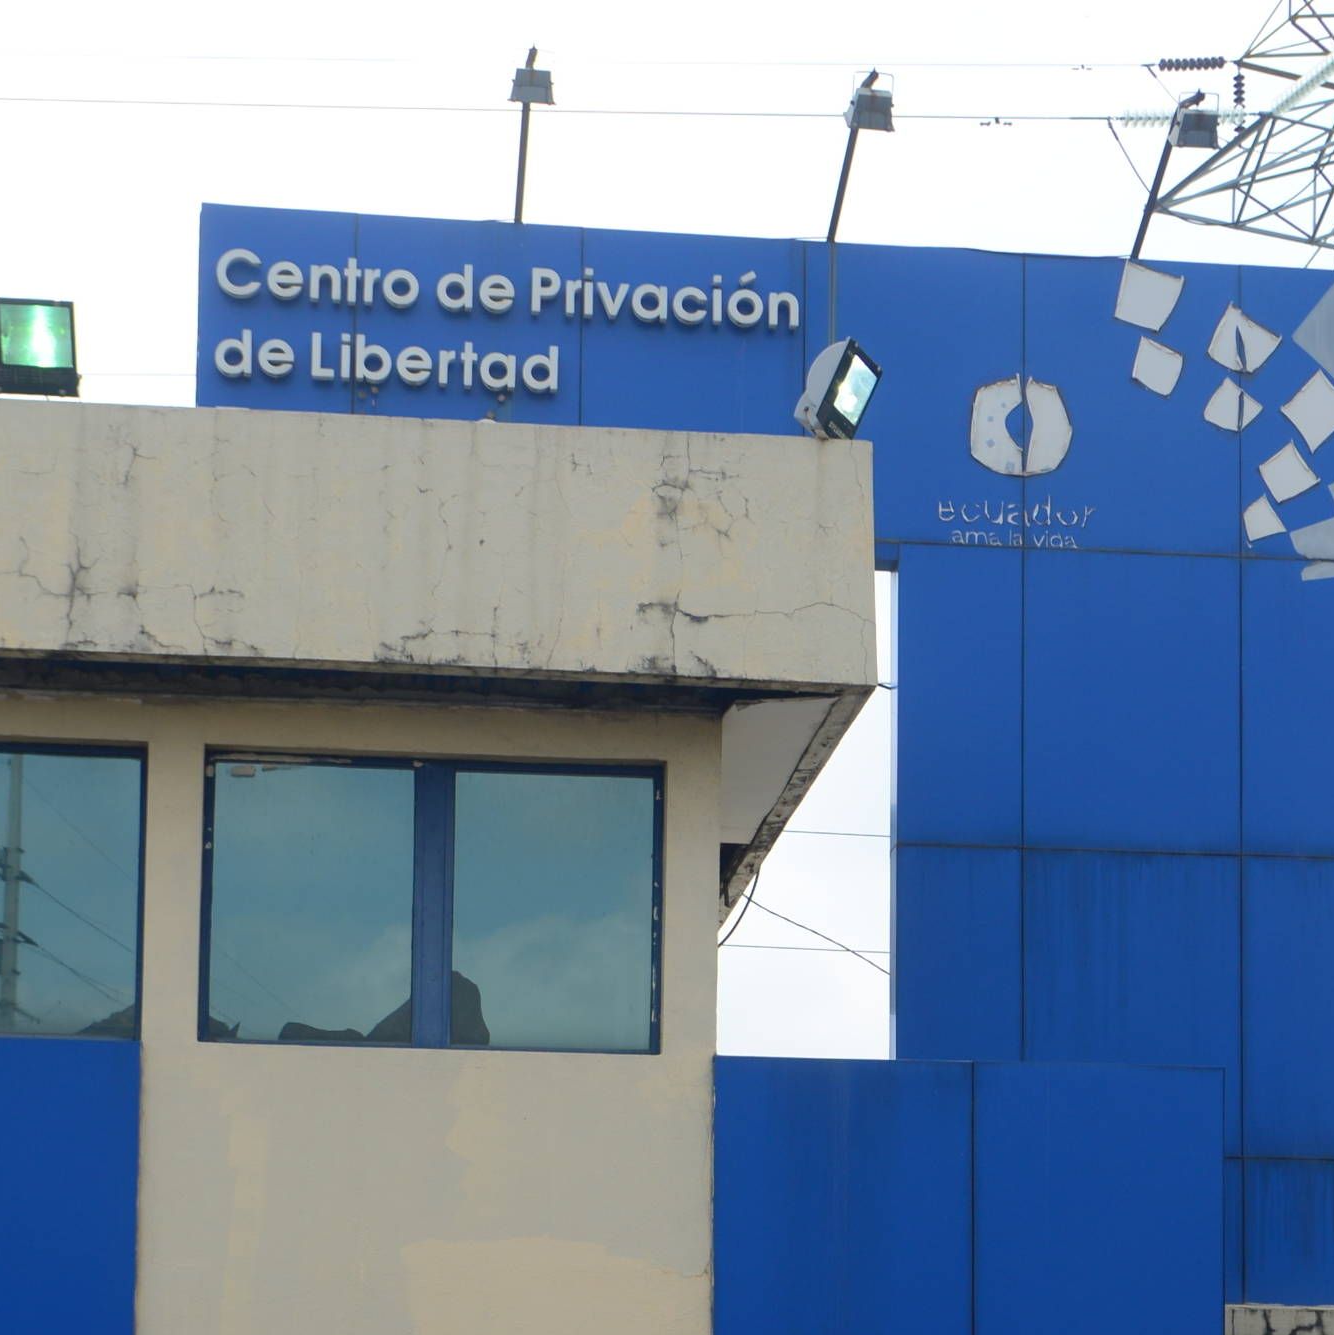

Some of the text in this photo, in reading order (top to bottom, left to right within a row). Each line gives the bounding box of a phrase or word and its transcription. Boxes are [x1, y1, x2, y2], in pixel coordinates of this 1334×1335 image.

[216, 248, 800, 330] Centro de Privación
[214, 329, 559, 394] de Libertad
[952, 529, 1078, 549] ama la vida
